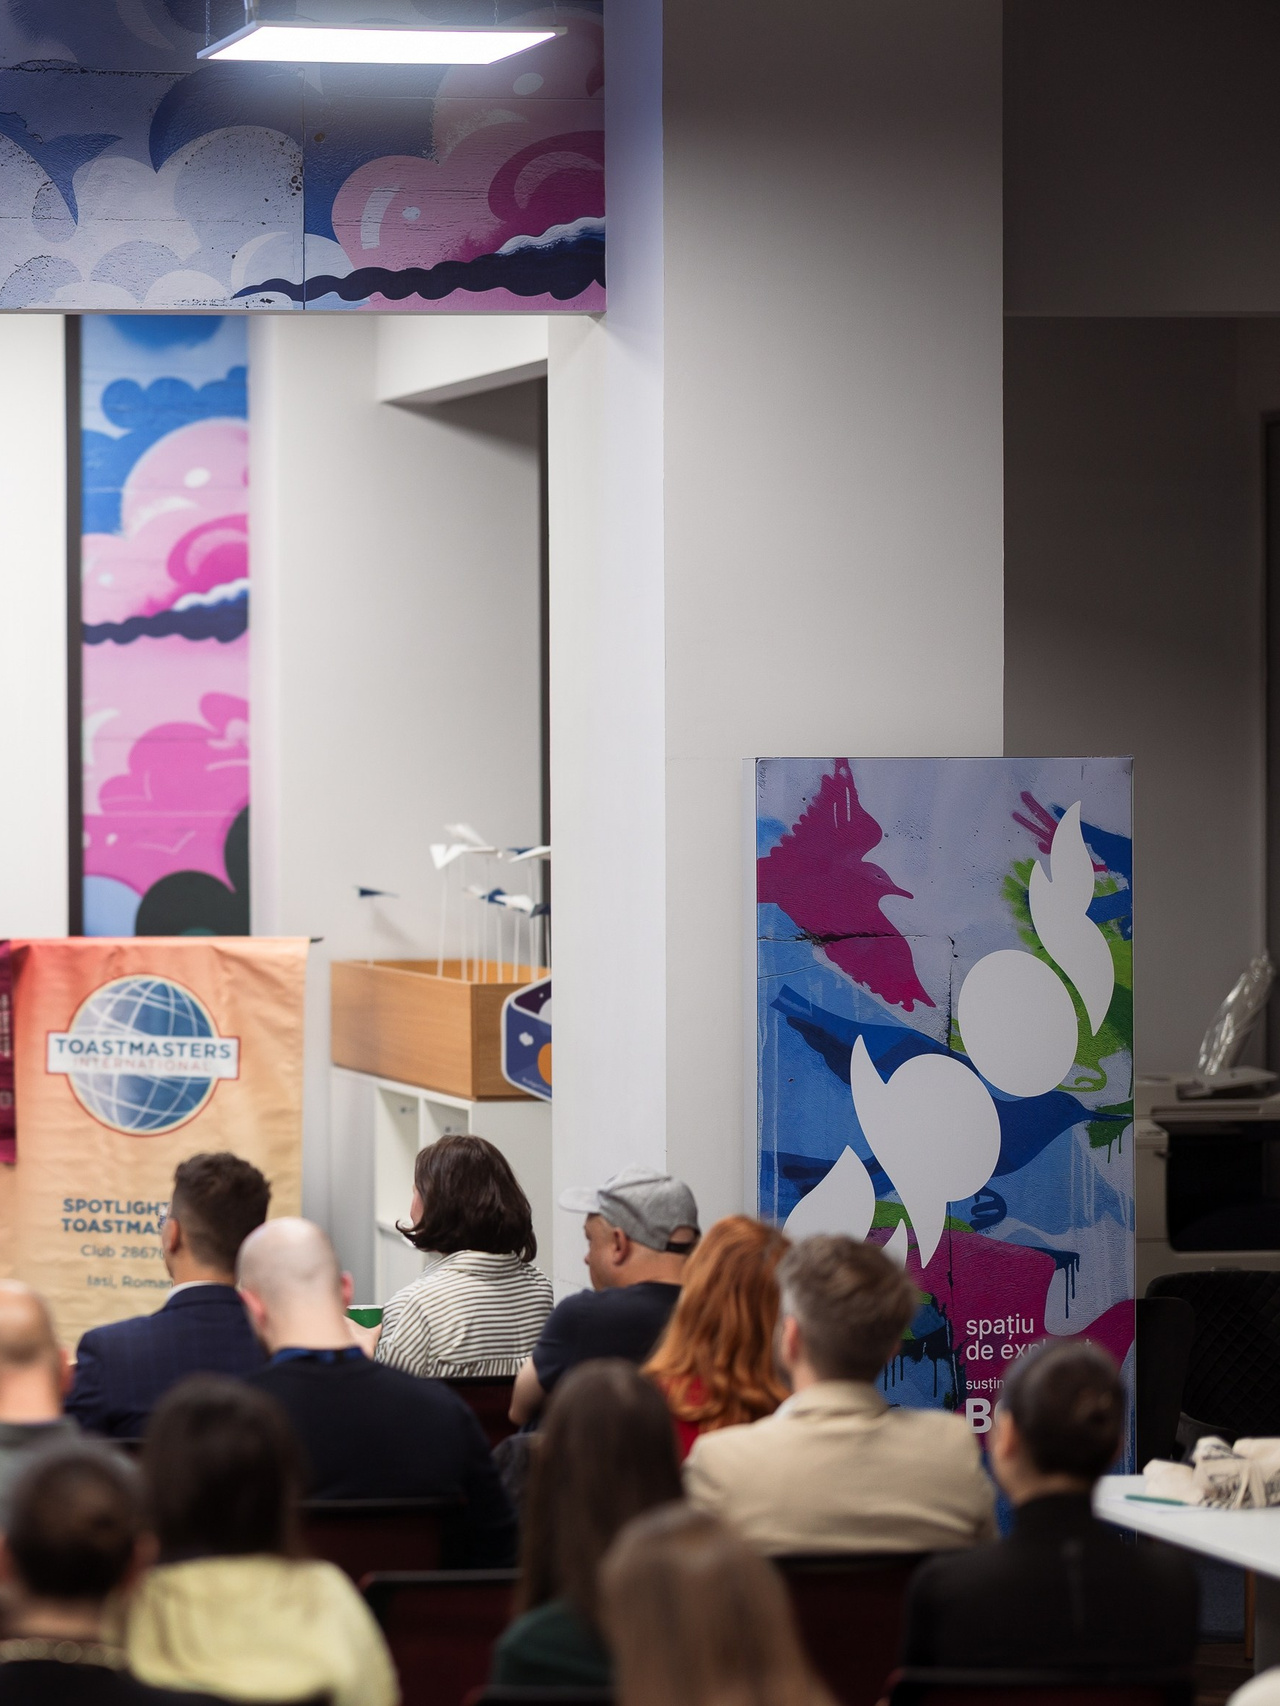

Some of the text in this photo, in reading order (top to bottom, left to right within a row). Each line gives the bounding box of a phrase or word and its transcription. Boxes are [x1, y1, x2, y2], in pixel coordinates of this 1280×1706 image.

[55, 1038, 232, 1059] TOASTMASTERS
[73, 1056, 210, 1072] INTERNATIONAL
[81, 1244, 116, 1258] Club
[122, 1275, 173, 1289] Roman
[966, 1313, 1034, 1340] spațiu
[966, 1340, 994, 1360] de
[965, 1377, 1005, 1392] susțin
